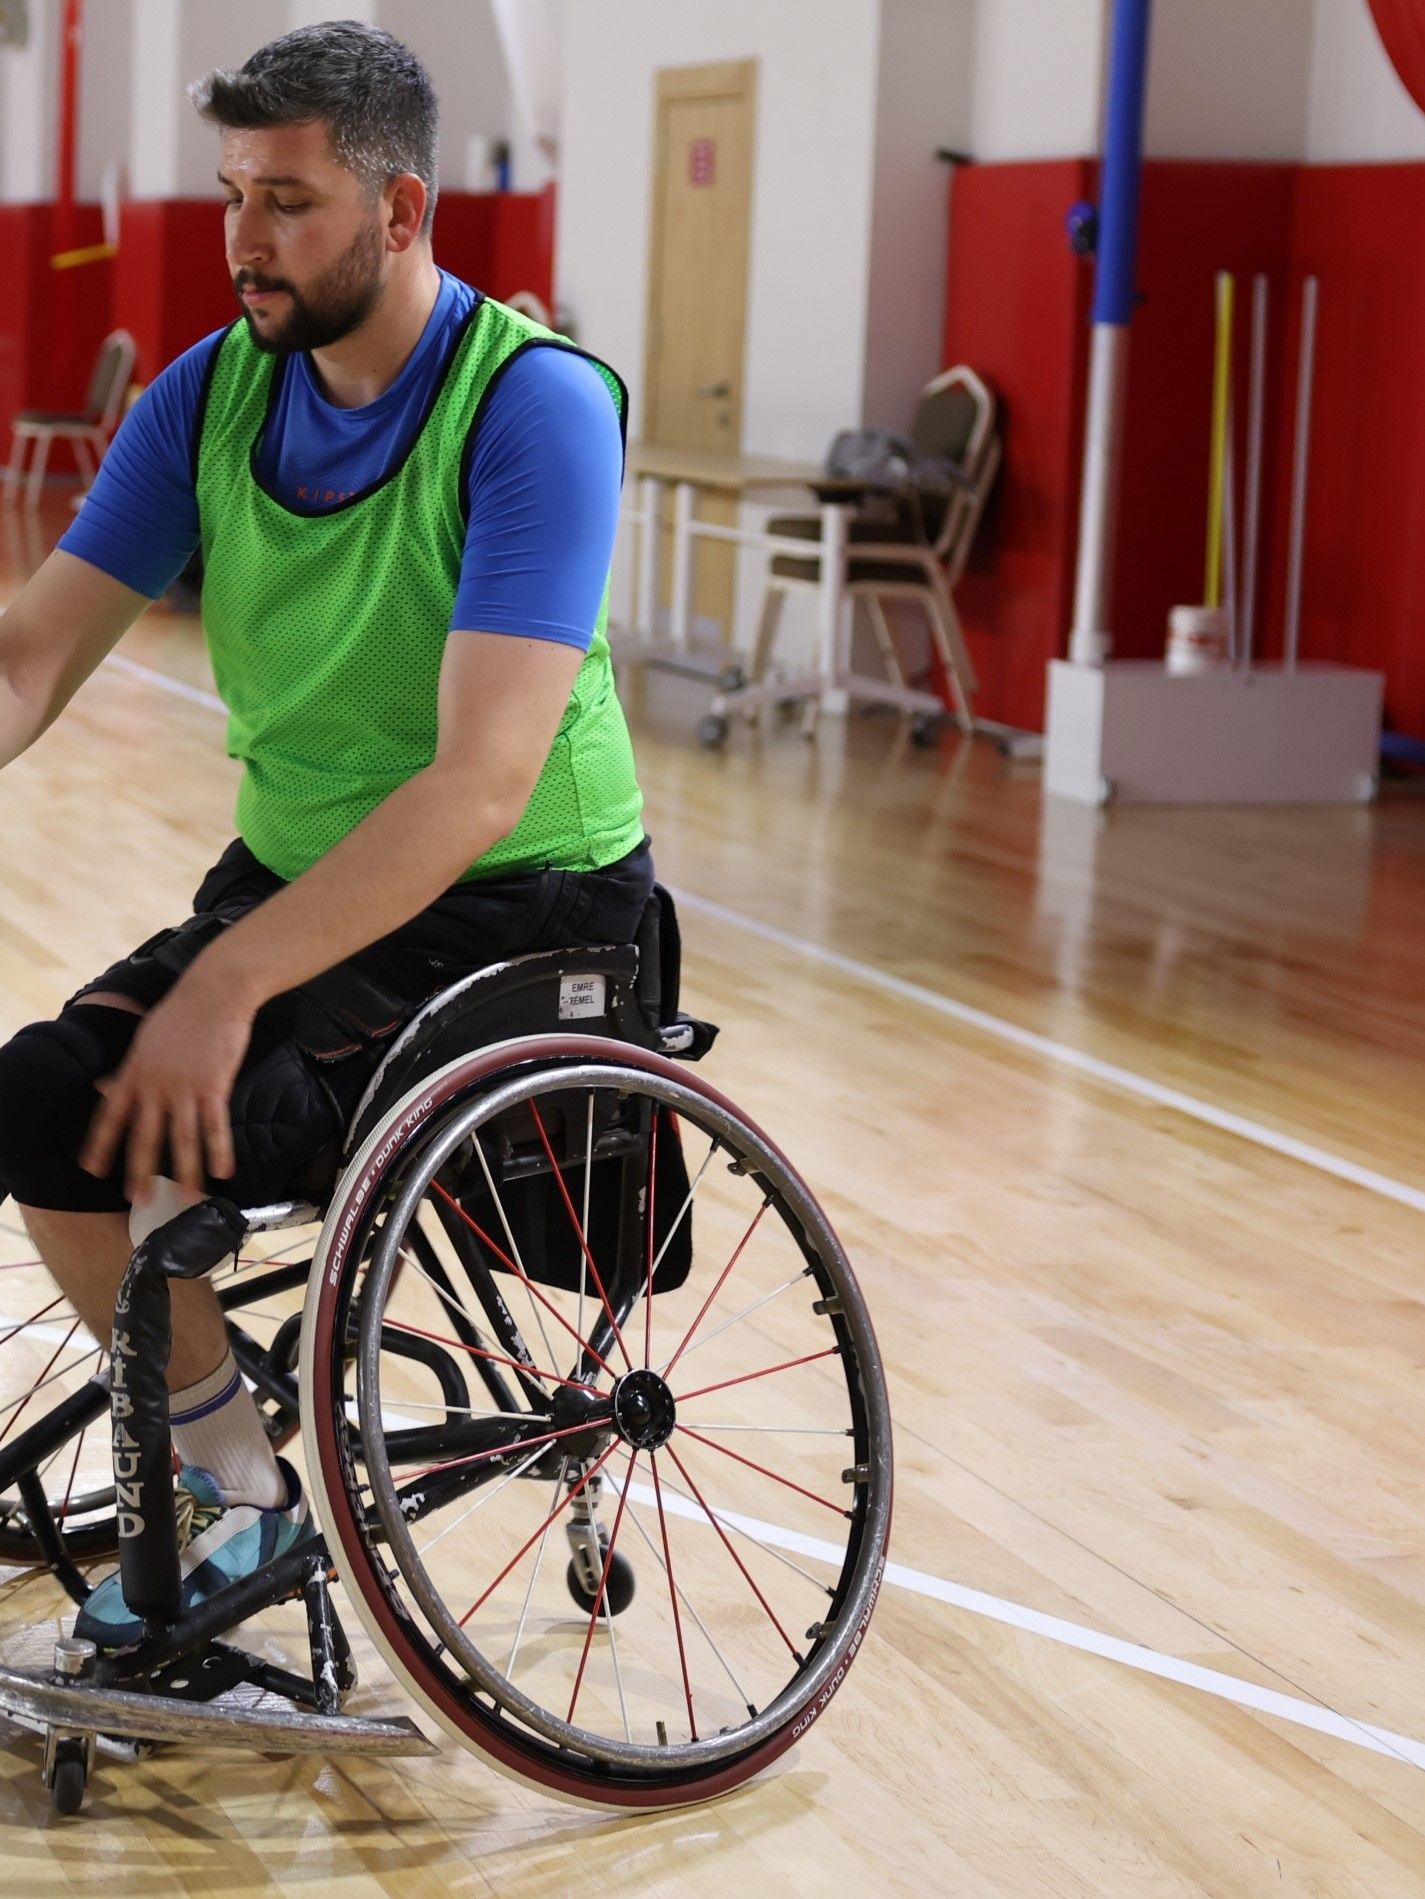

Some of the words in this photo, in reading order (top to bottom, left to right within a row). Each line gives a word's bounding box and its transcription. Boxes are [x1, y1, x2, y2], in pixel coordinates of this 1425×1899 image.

[569, 995, 594, 1005] TEMEL
[572, 982, 594, 992] EMRE
[329, 1176, 374, 1287] SCHWALBE
[375, 1128, 405, 1169] DUNK
[406, 1096, 433, 1128] KING
[819, 1666, 846, 1707] DUNK
[792, 1709, 817, 1738] KING
